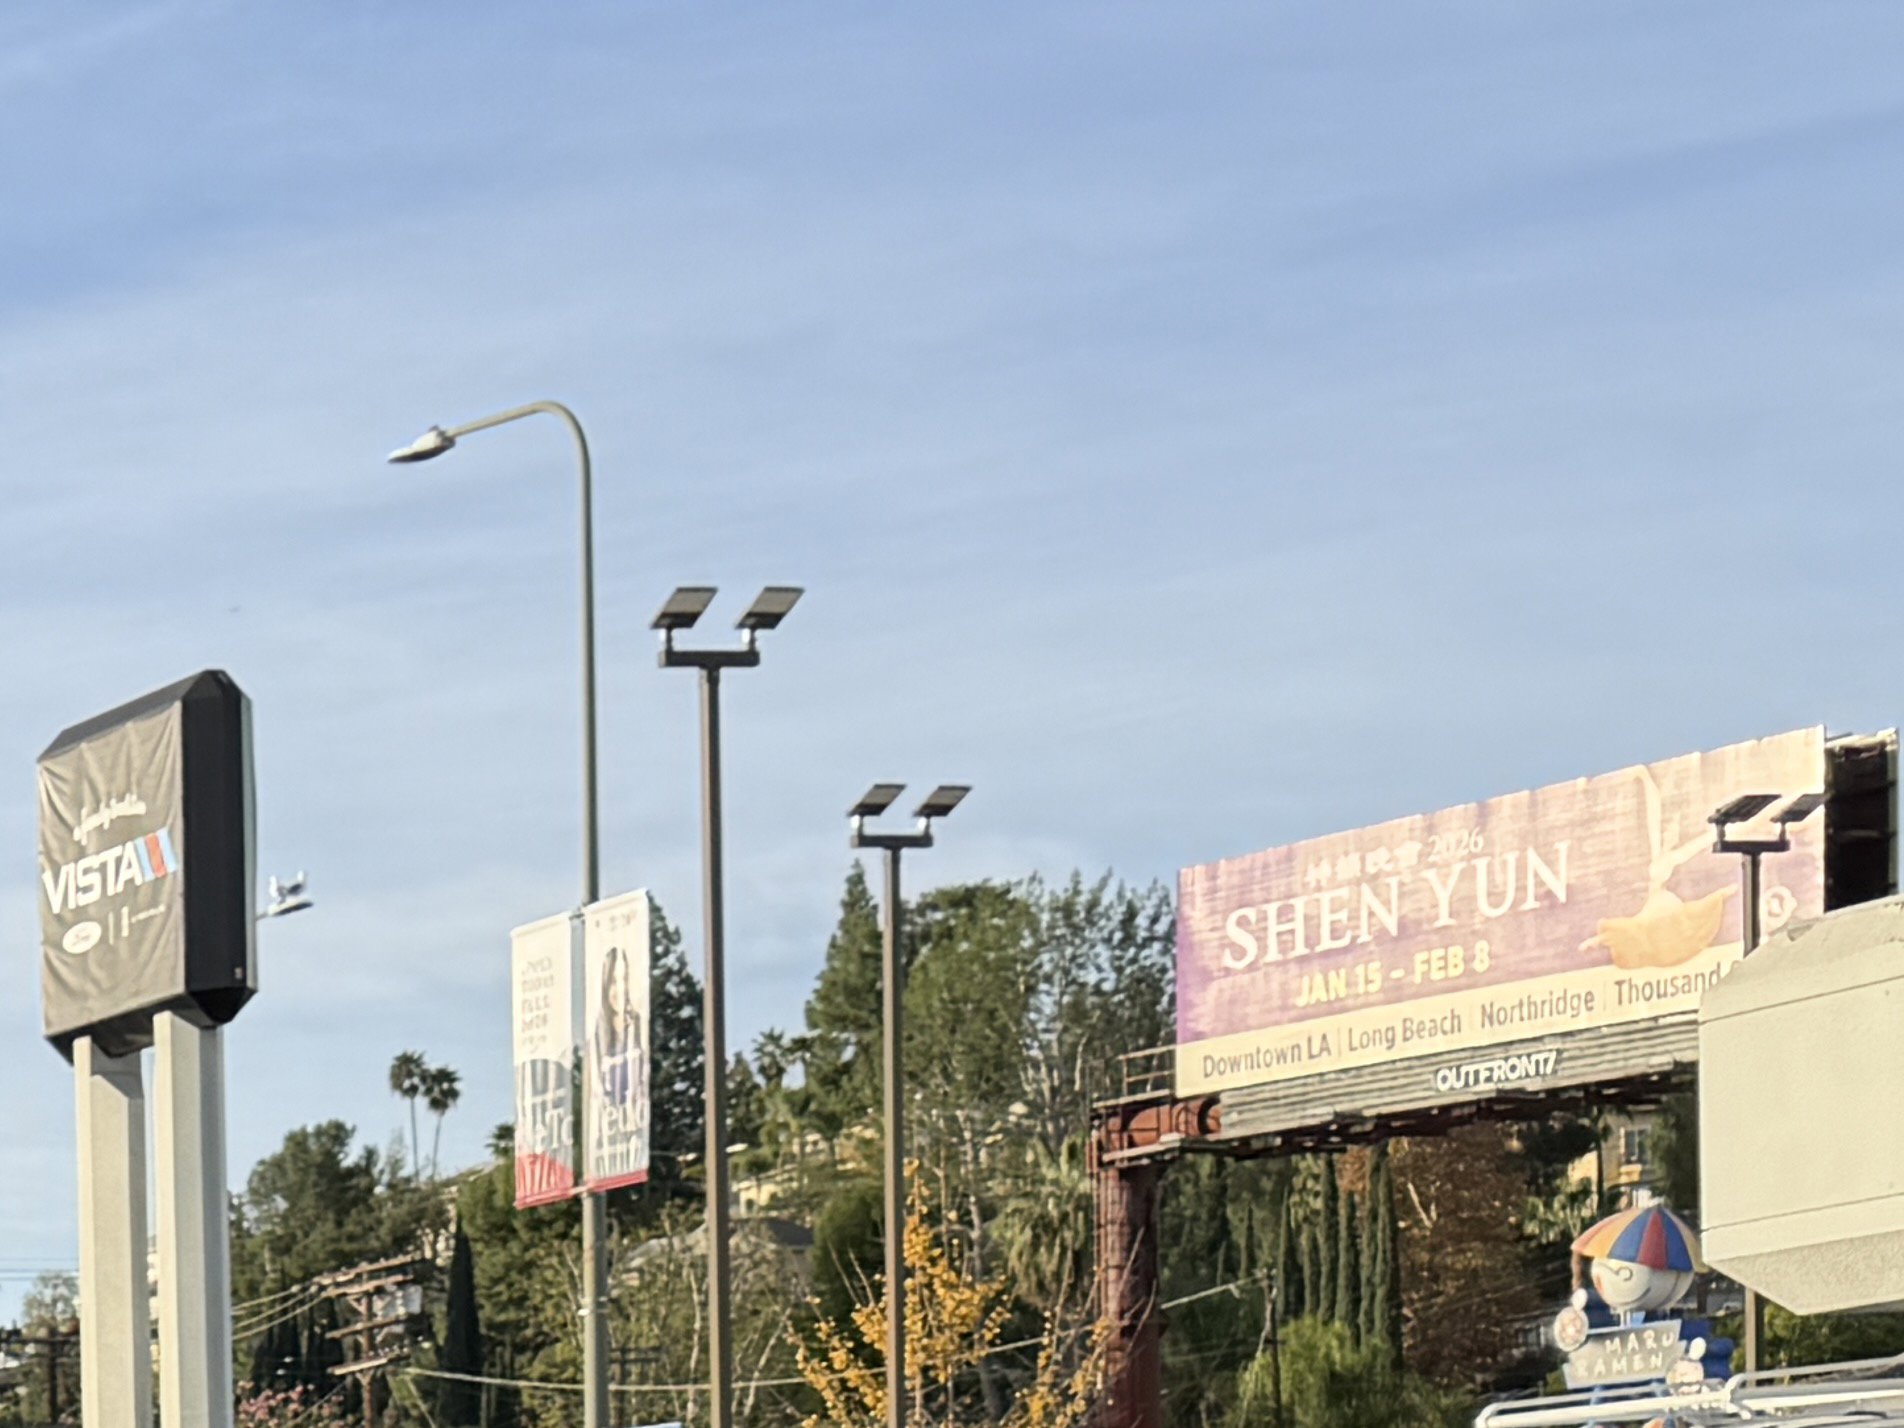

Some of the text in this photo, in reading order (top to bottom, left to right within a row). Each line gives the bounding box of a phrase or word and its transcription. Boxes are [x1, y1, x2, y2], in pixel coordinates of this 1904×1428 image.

[41, 840, 144, 915] VISTA
[1427, 827, 1484, 862] 2026
[1223, 840, 1572, 970] SHEN YUN
[1295, 966, 1348, 1007] JAN
[1357, 961, 1384, 992] 15
[1414, 944, 1465, 985] FEB
[1472, 939, 1491, 974] 8
[1202, 961, 1722, 1079] Downtown LA Long Beach Northridge Thousand
[1573, 1351, 1664, 1378] RAMEN
[1604, 1328, 1675, 1355] MARU
